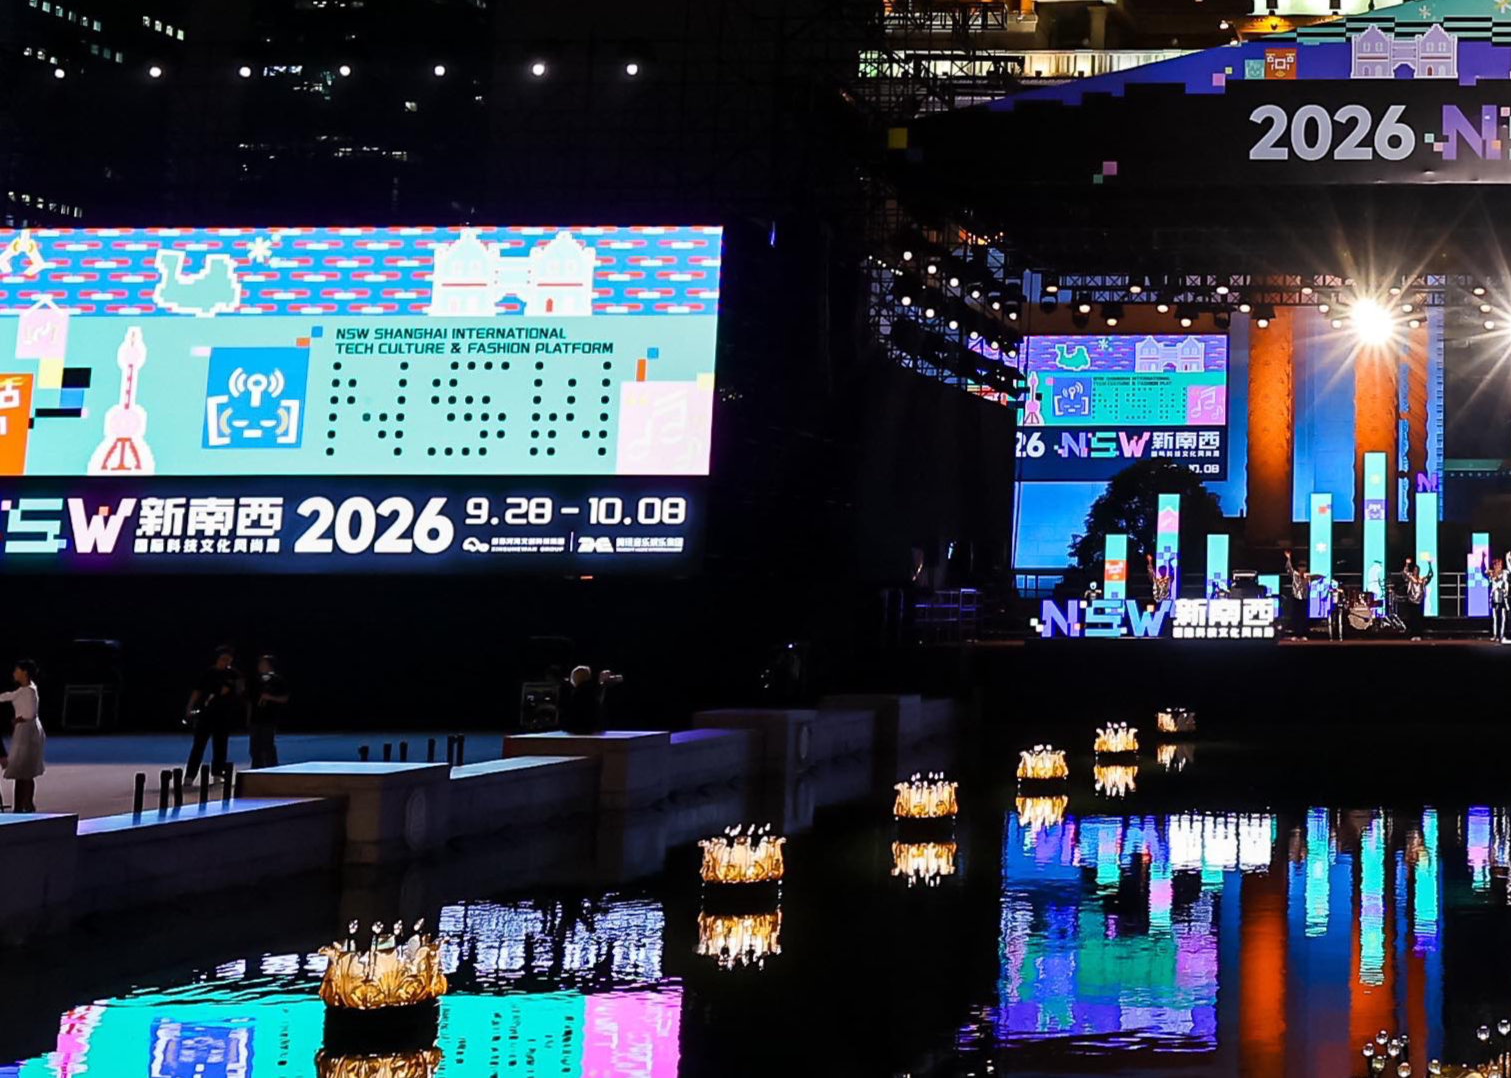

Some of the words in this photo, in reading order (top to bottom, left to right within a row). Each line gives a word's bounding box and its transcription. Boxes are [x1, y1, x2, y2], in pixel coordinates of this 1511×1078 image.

[1249, 104, 1416, 161] 2026
[335, 343, 374, 354] TECH
[378, 343, 445, 354] CULTURE
[450, 343, 462, 354] &
[467, 343, 531, 354] FASHION
[535, 342, 614, 354] PLATFORM
[336, 328, 369, 339] NSW
[374, 328, 447, 339] SHANGHAI
[451, 328, 567, 339] INTERNATIONAL
[1054, 432, 1150, 458] NSW
[1151, 431, 1220, 450] 新南西
[136, 497, 284, 537] 新南西
[294, 496, 454, 554] 2026
[1030, 599, 1173, 638] NSW
[1173, 598, 1274, 625] 新南西
